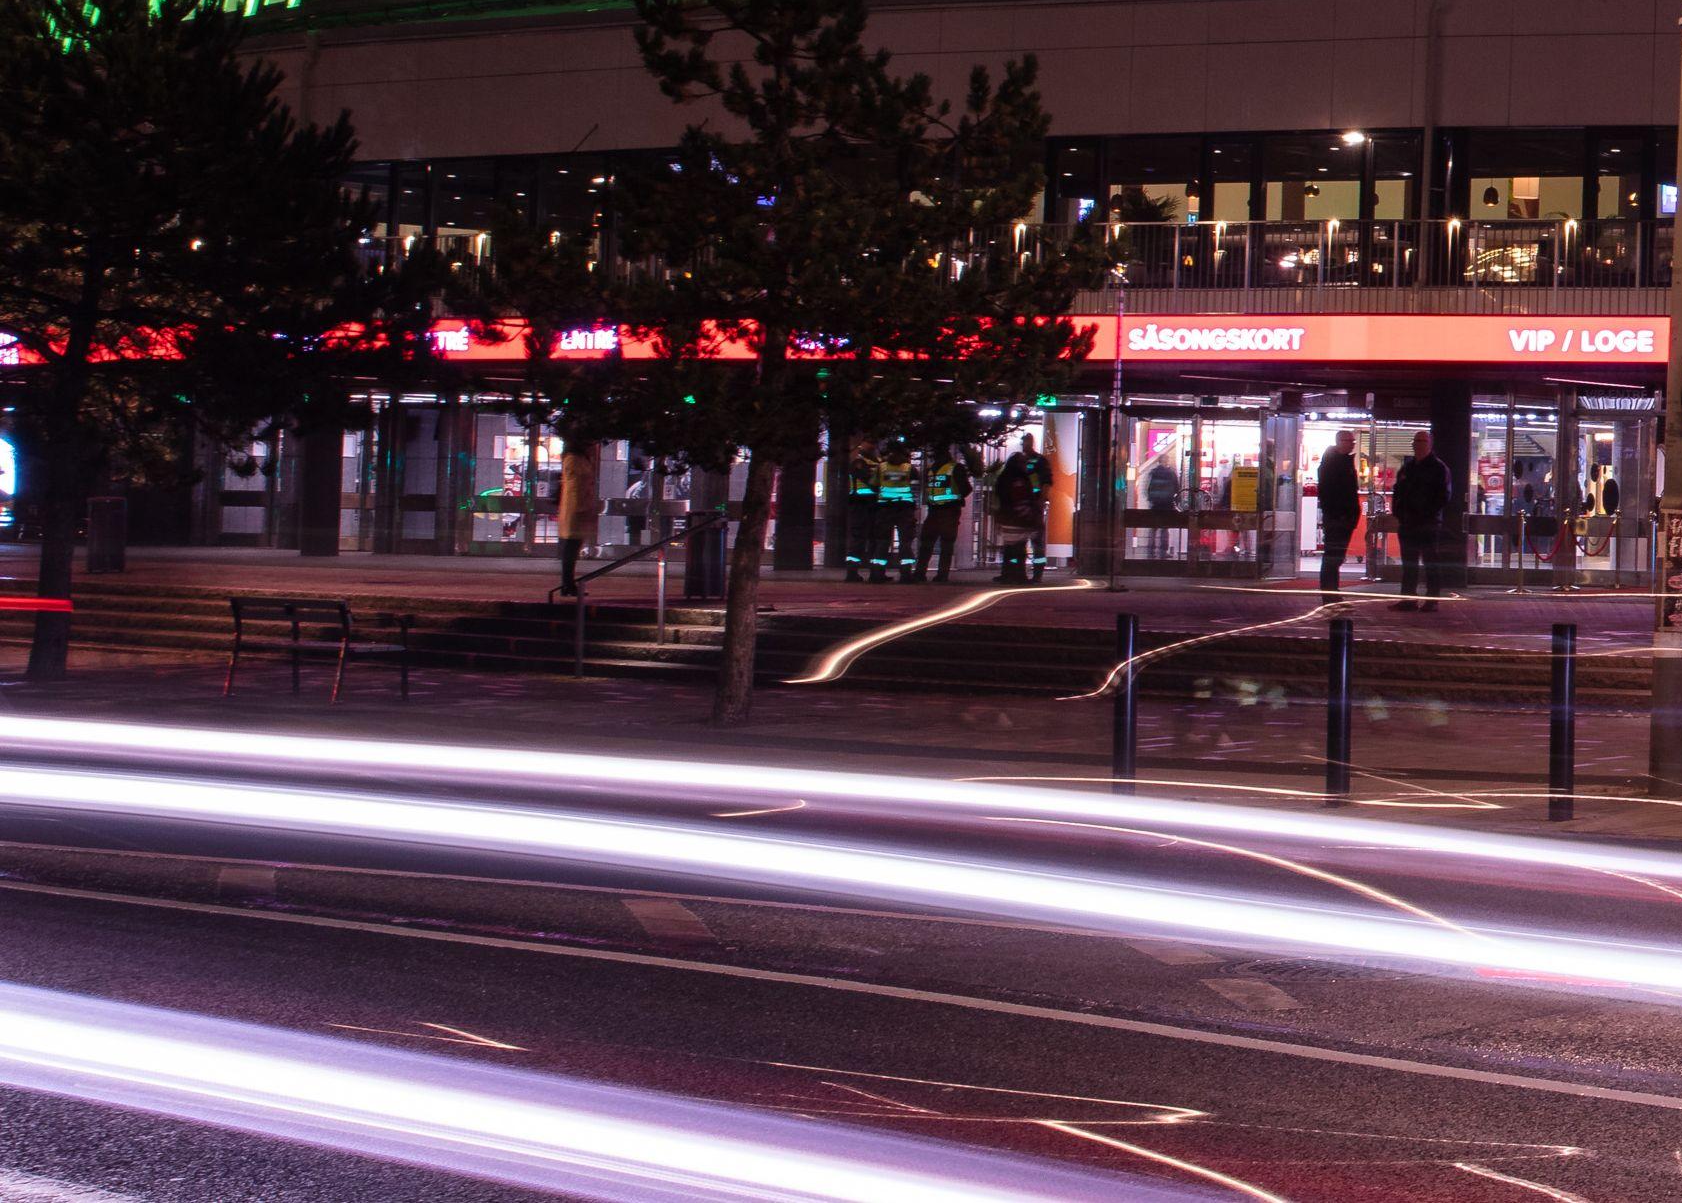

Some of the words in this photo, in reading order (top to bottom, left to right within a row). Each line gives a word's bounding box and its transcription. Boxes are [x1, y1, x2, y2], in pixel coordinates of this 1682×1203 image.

[1128, 324, 1305, 351] SÄSONGSKORT
[1508, 329, 1555, 352] VIP
[1581, 330, 1654, 353] LOGE
